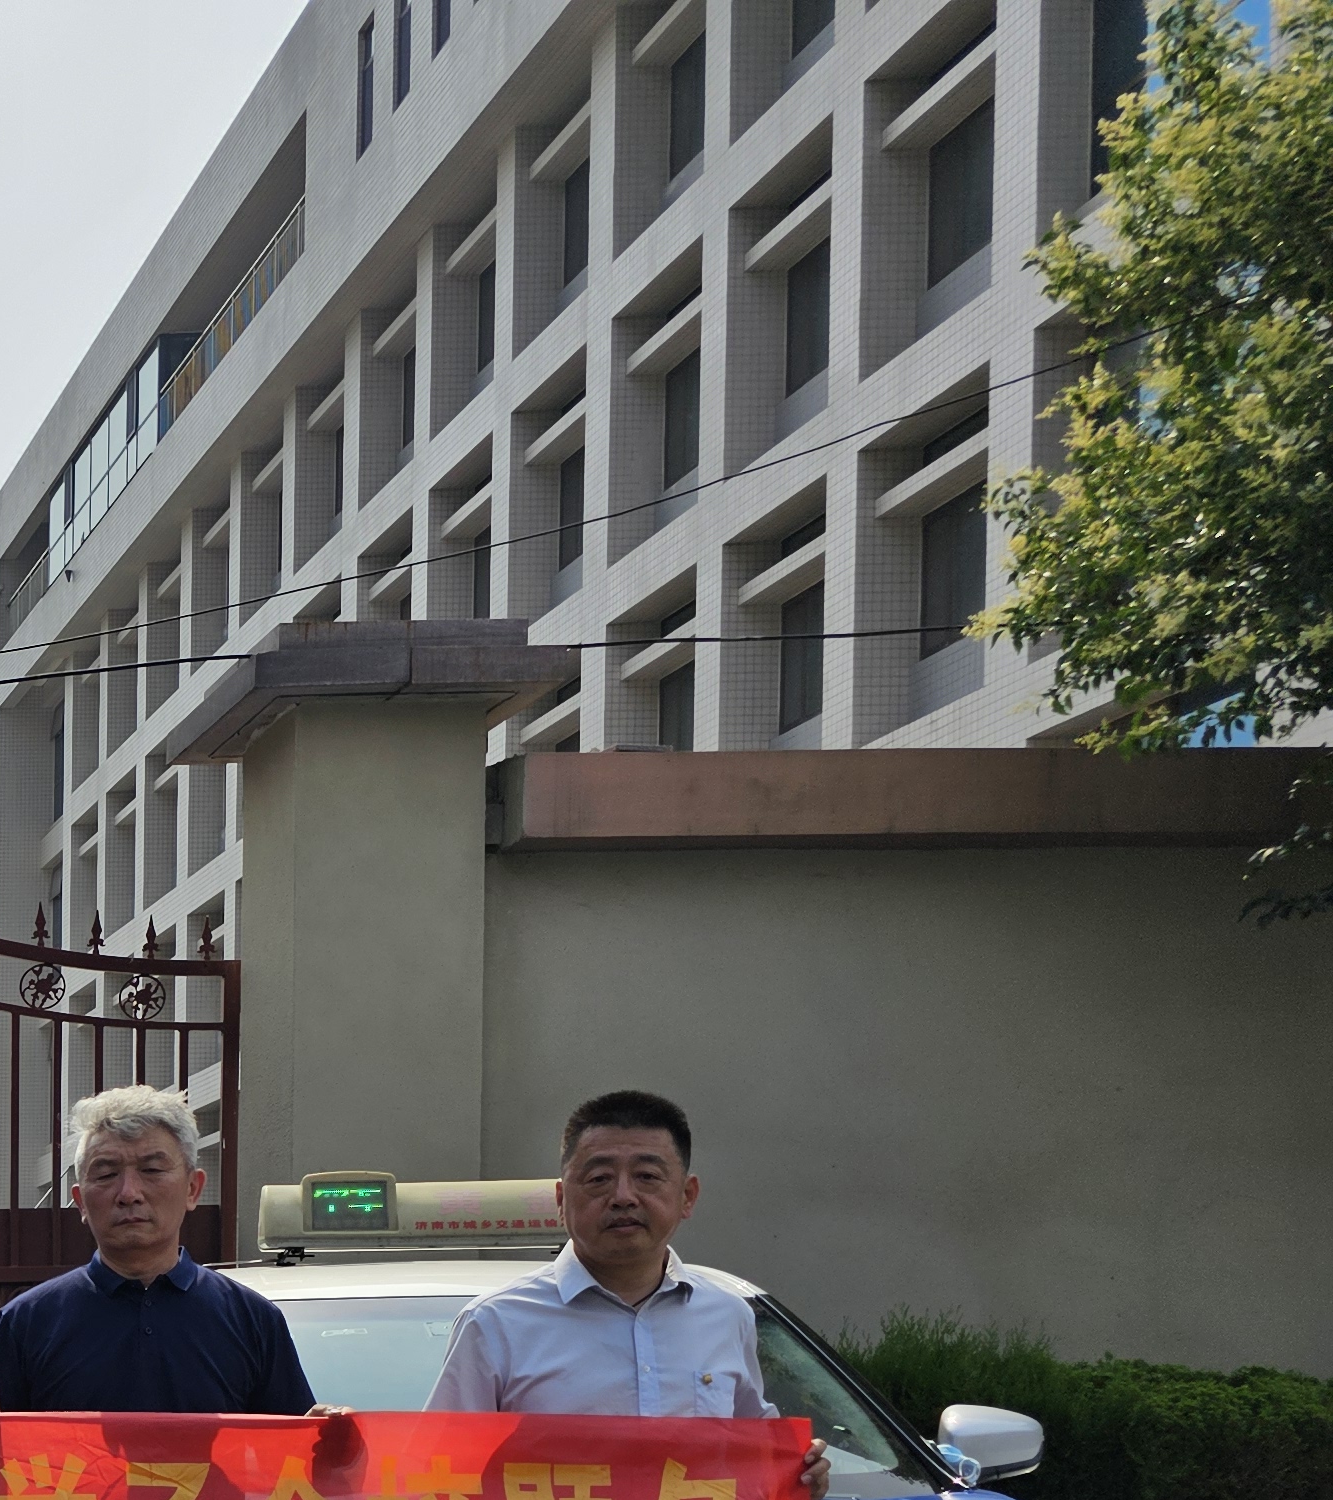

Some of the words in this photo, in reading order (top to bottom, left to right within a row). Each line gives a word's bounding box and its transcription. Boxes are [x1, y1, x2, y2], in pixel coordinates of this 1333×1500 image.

[415, 1219, 565, 1231] 济南市城乡交通运输
